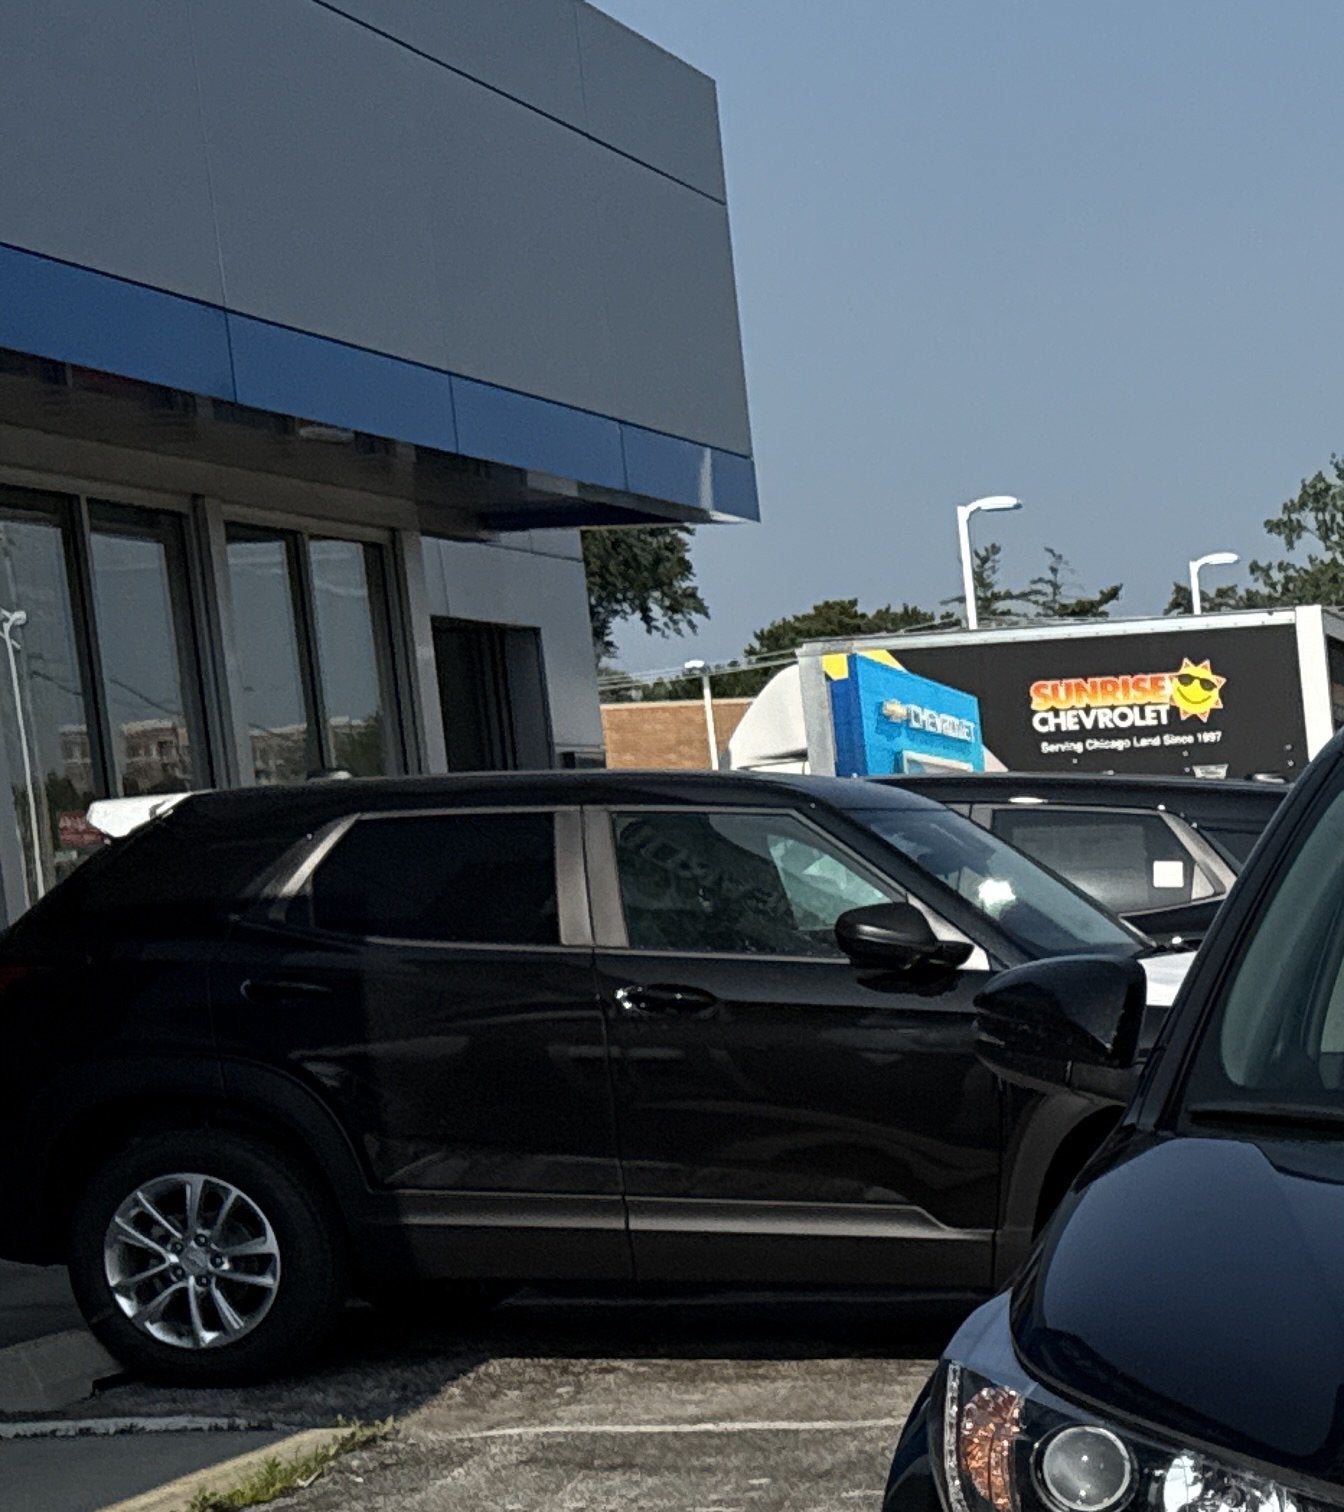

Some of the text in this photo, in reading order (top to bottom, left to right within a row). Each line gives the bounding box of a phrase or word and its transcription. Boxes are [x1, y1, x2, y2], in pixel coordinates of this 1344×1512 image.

[1030, 673, 1168, 711] SUNRISE
[1032, 704, 1170, 733] CHEVROLET
[1040, 741, 1084, 754] Serving
[1085, 738, 1131, 751] Chicago
[1133, 735, 1161, 747] Land
[1163, 733, 1194, 746] Since
